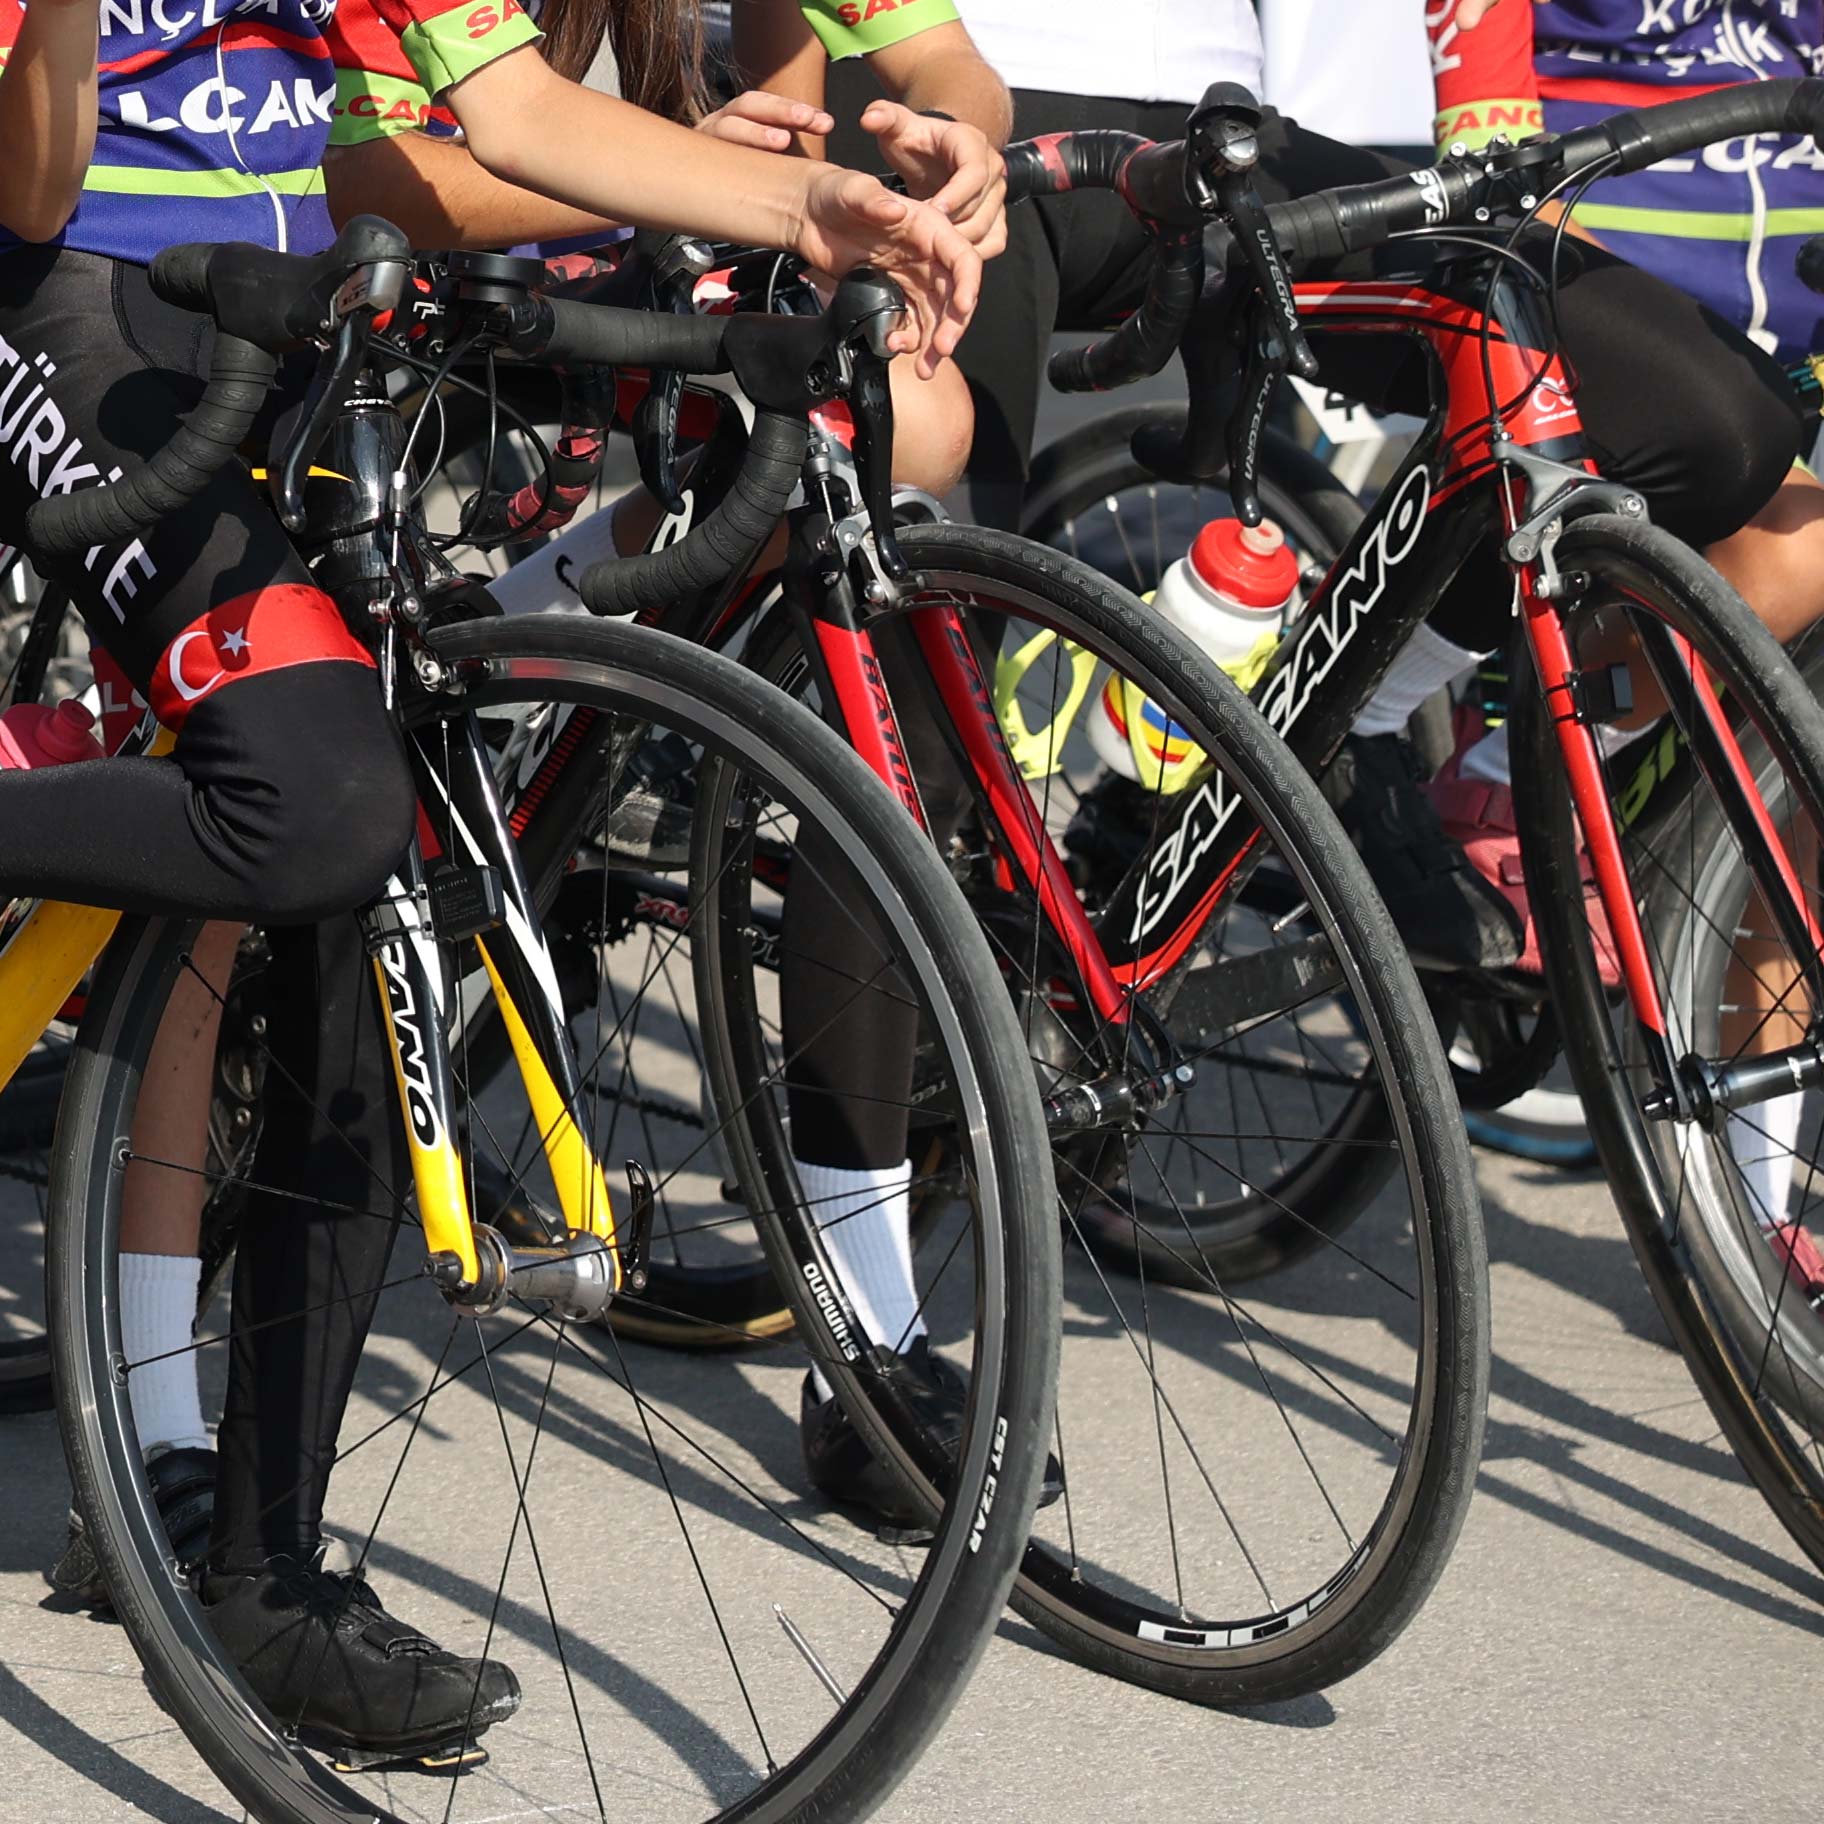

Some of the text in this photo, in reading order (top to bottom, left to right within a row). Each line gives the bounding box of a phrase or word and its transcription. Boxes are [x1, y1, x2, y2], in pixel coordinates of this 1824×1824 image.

[1256, 229, 1299, 332] ULTEGRA
[1244, 372, 1273, 481] ULTEGRA
[802, 1261, 862, 1363] SHIMANO
[968, 1414, 1009, 1555] CST CZAR
